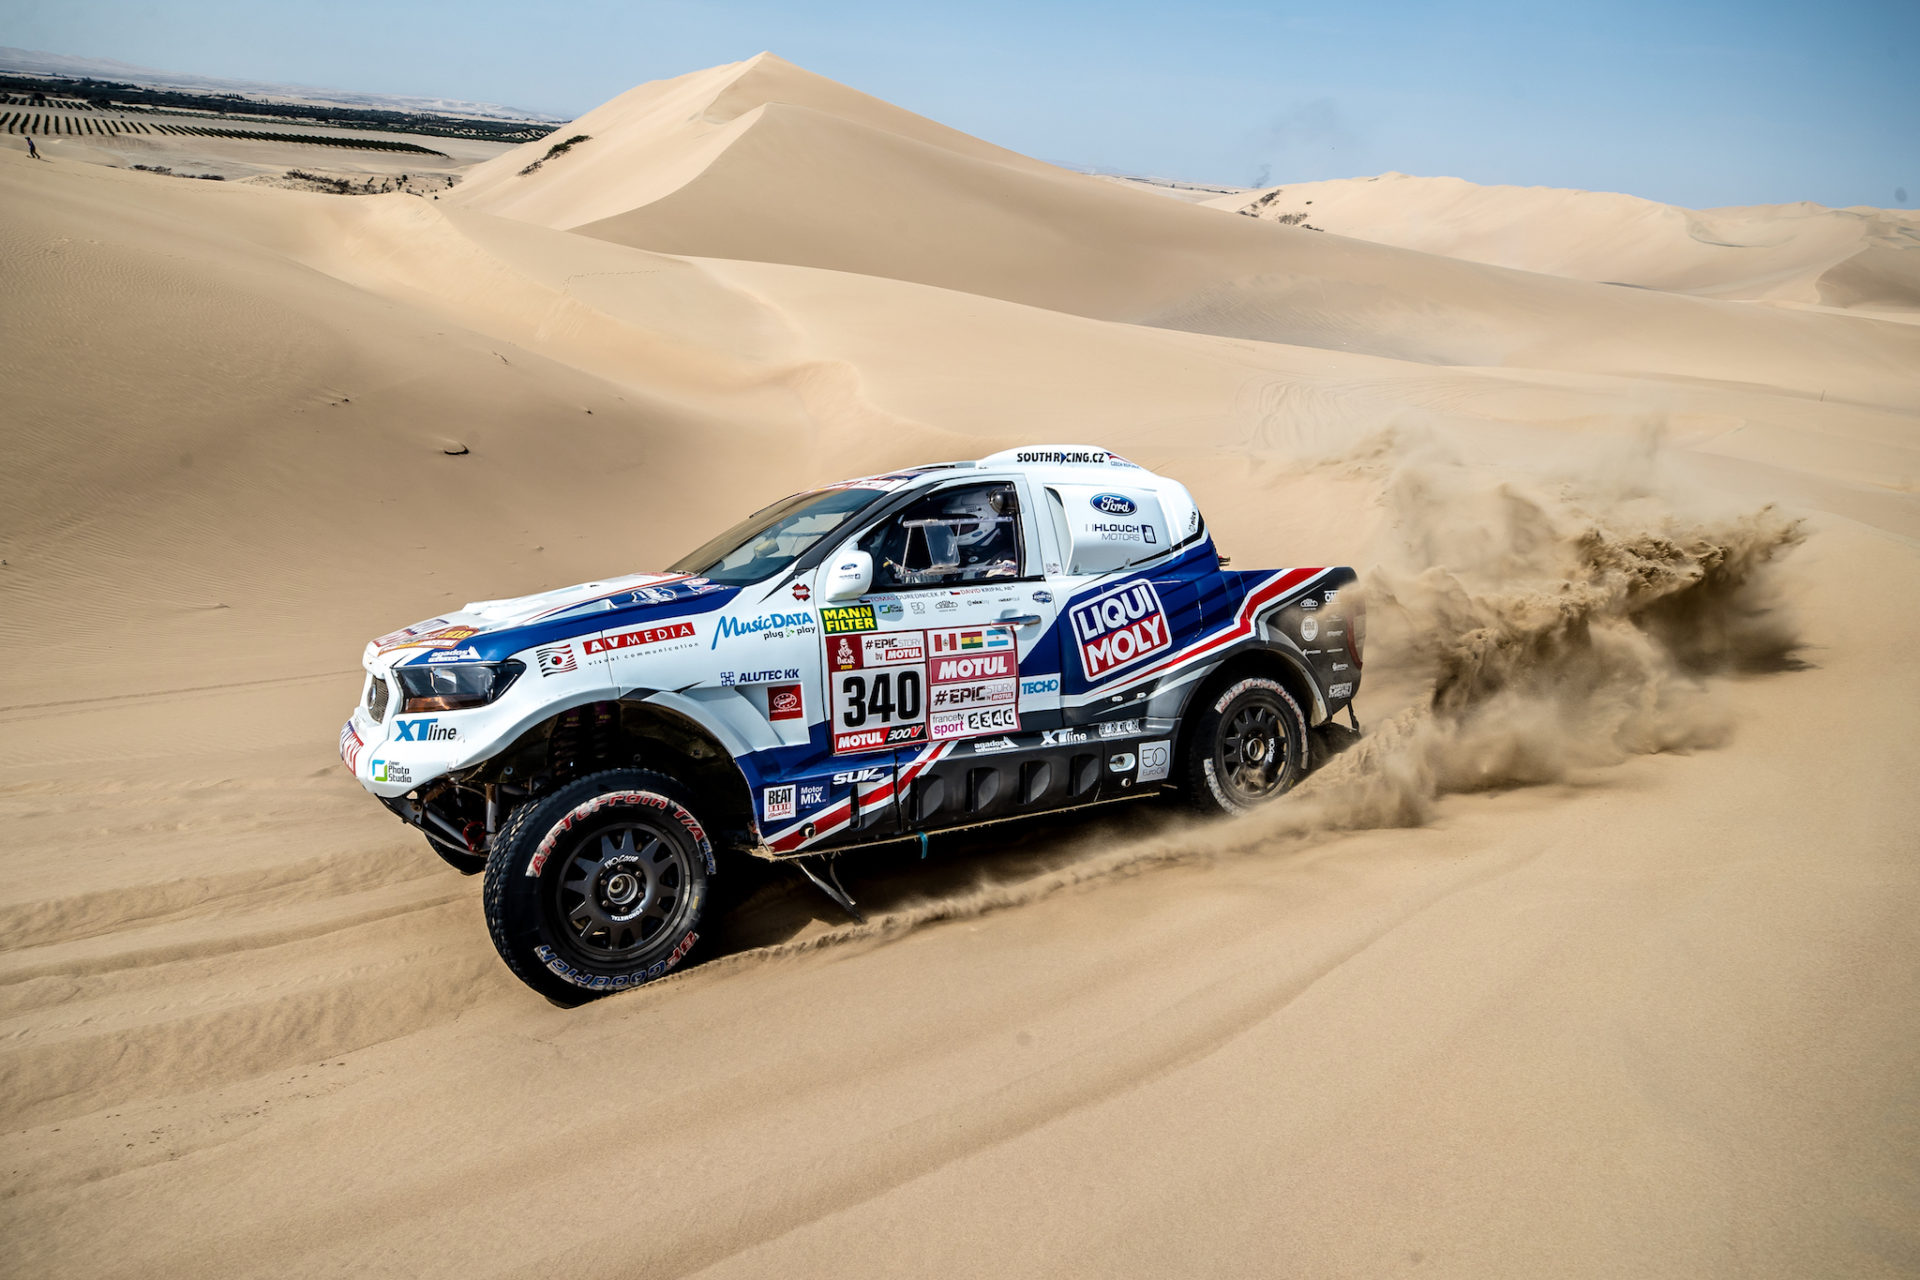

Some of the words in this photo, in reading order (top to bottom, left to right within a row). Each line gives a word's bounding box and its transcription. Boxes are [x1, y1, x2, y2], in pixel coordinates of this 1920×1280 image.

[1100, 496, 1131, 512] Ford
[1102, 533, 1140, 541] MOTORS
[823, 606, 873, 621] MANN
[1077, 585, 1156, 641] LIQUI
[826, 617, 875, 632] FILTER
[763, 630, 784, 640] plug
[796, 626, 816, 635] play
[1086, 614, 1161, 674] MOLY
[588, 656, 620, 666] visual
[624, 642, 699, 659] communication
[887, 649, 921, 660] MOTUL
[938, 656, 1008, 680] MOTUL
[739, 670, 783, 683] ALUTEC
[784, 669, 800, 679] KK
[1021, 679, 1059, 695] TECHO
[843, 671, 921, 728] 340
[934, 721, 964, 736] sport
[837, 732, 883, 749] MOTUL
[887, 725, 924, 742] 300V
[388, 765, 410, 774] Photo
[832, 768, 879, 785] SUV
[388, 774, 412, 783] Studio
[769, 788, 793, 805] BEAT
[801, 786, 823, 794] Motor
